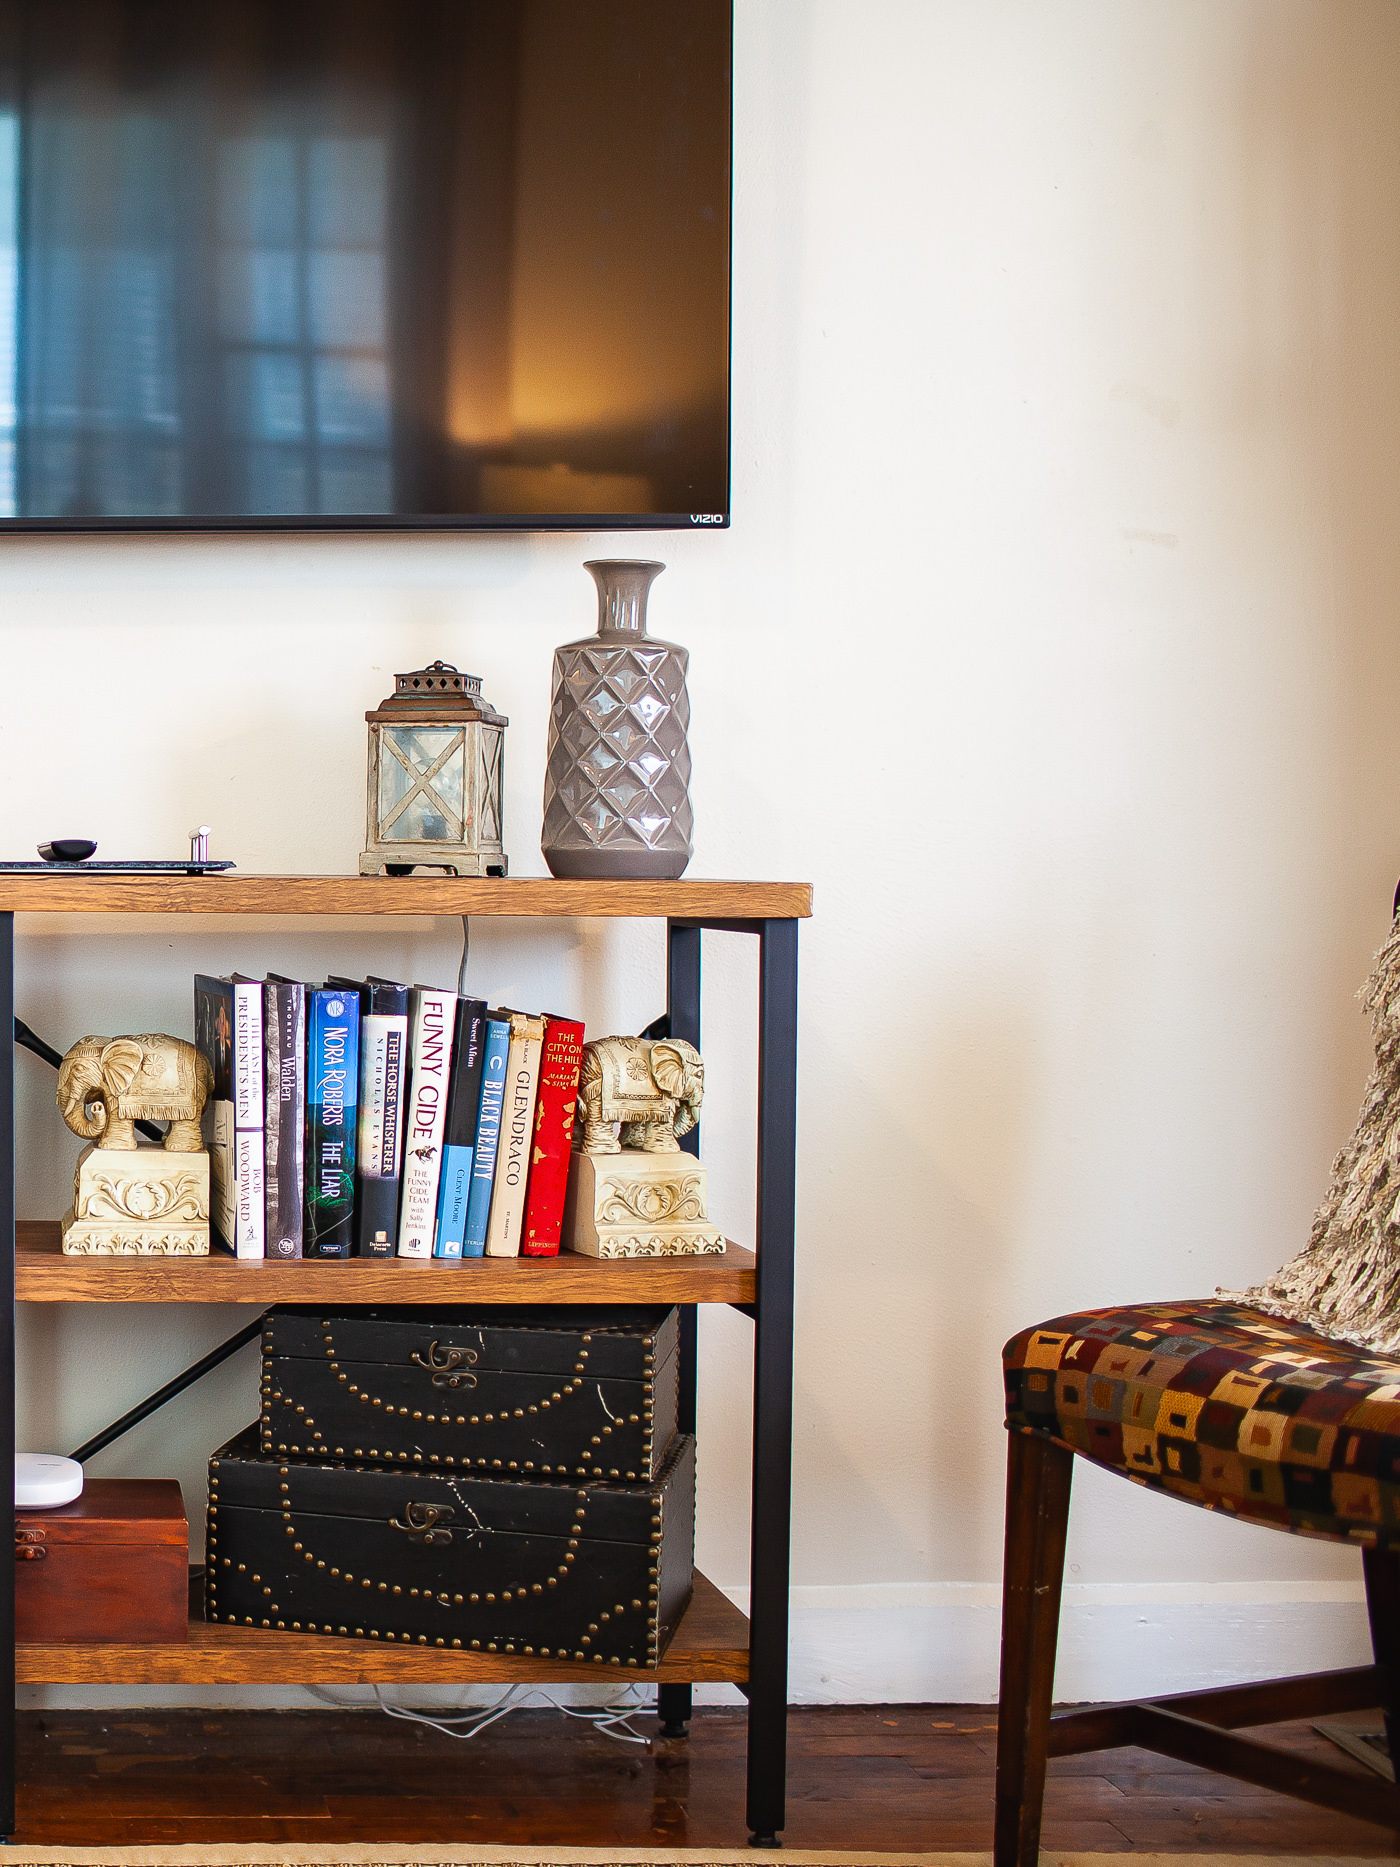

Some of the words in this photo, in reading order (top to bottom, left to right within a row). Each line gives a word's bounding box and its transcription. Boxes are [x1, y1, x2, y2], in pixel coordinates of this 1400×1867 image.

[690, 514, 723, 524] VIZIO
[238, 997, 249, 1084] PRESIDENT'S
[251, 1017, 260, 1042] THE
[420, 1001, 443, 1077] FUNNY
[470, 1017, 481, 1042] Sweet
[557, 1032, 575, 1043] THE
[251, 1046, 260, 1073] LAST
[323, 1027, 348, 1066] NORA
[388, 1035, 399, 1060] THE
[467, 1044, 478, 1068] Afton
[546, 1053, 563, 1063] THE
[564, 1055, 580, 1065] HILL
[547, 1043, 567, 1053] CITY
[568, 1045, 582, 1054] ON
[281, 1056, 296, 1101] Walden
[374, 1038, 384, 1114] NICHOLAS
[386, 1063, 398, 1103] HORSE
[239, 1088, 249, 1118] MEN
[317, 1069, 347, 1126] ROBERTS
[413, 1085, 439, 1139] CIDE
[480, 1079, 503, 1124] BLACK
[382, 1105, 397, 1173] WHISPERER
[505, 1071, 530, 1186] GLENDRACO
[321, 1141, 343, 1164] THE
[371, 1124, 380, 1170] EVANS
[474, 1126, 498, 1180] BEAUTY
[240, 1140, 250, 1221] WOODWARD
[253, 1169, 261, 1193] BOB
[321, 1169, 343, 1199] LIAR
[407, 1178, 432, 1186] FUNNY
[413, 1169, 428, 1178] THE
[408, 1195, 430, 1204] TEAM
[409, 1187, 429, 1195] CIDE
